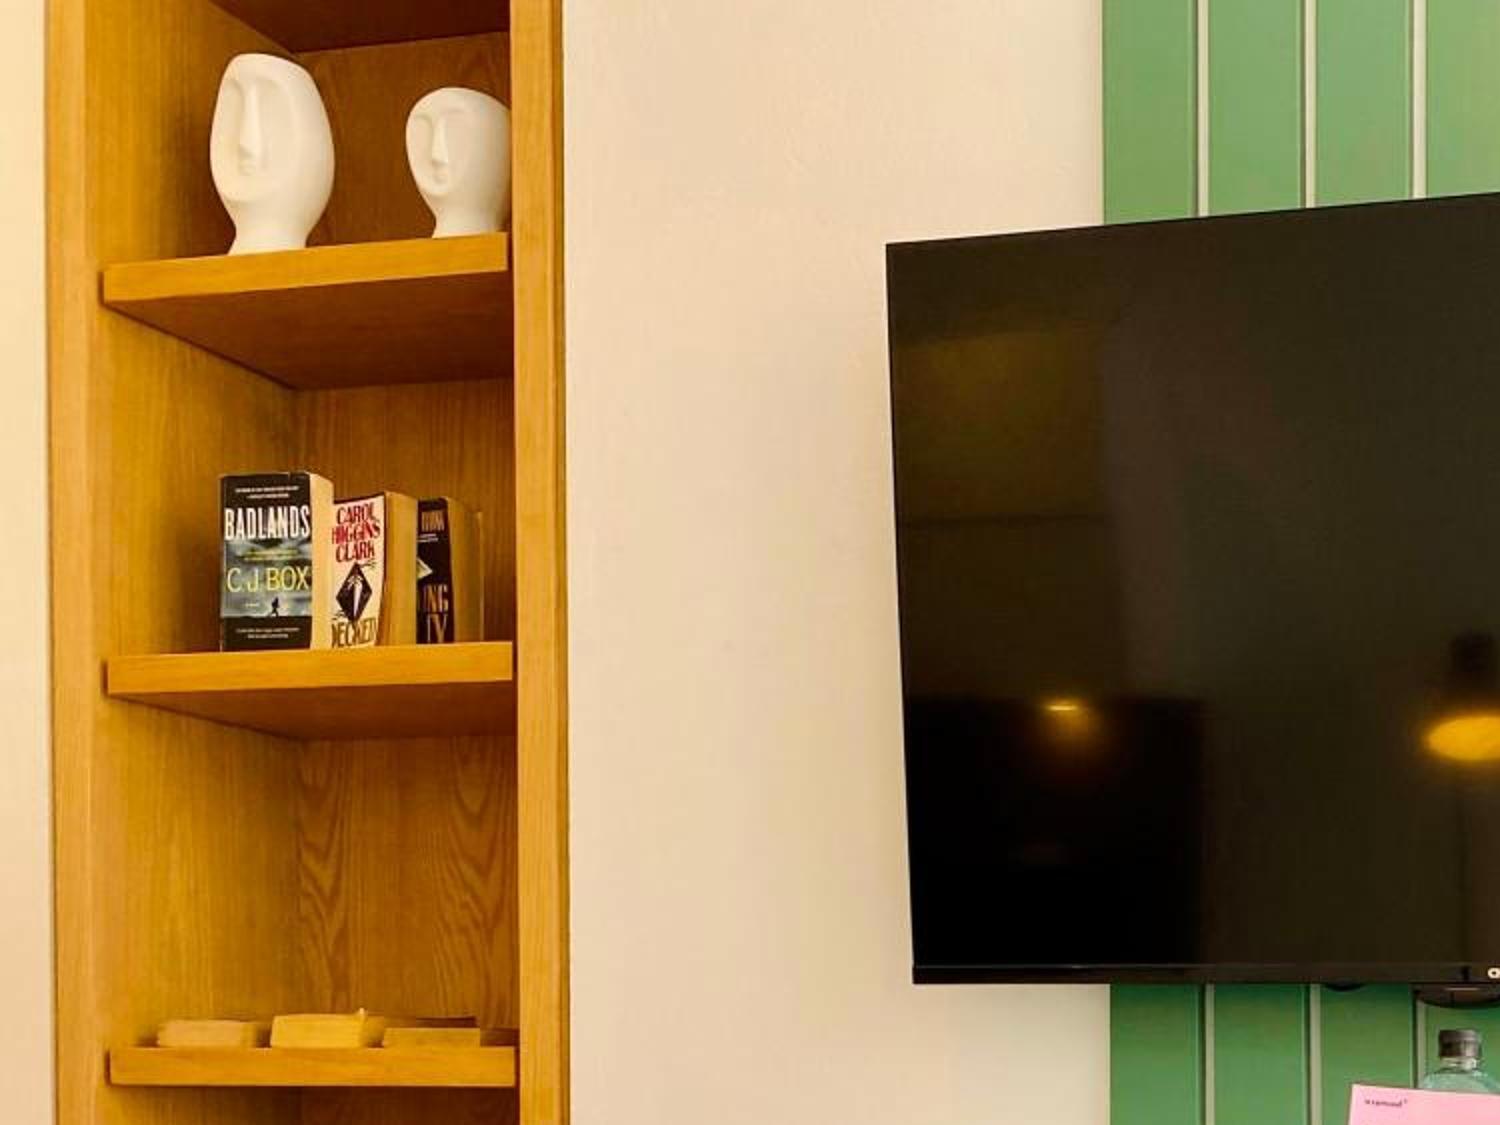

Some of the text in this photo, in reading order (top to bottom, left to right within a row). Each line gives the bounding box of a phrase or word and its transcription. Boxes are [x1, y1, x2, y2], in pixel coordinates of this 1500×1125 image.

[224, 504, 310, 541] BADLANDS
[336, 502, 377, 524] CAROL
[332, 519, 380, 544] HIGGINS
[335, 540, 375, 562] CLARK
[266, 565, 310, 592] BOX
